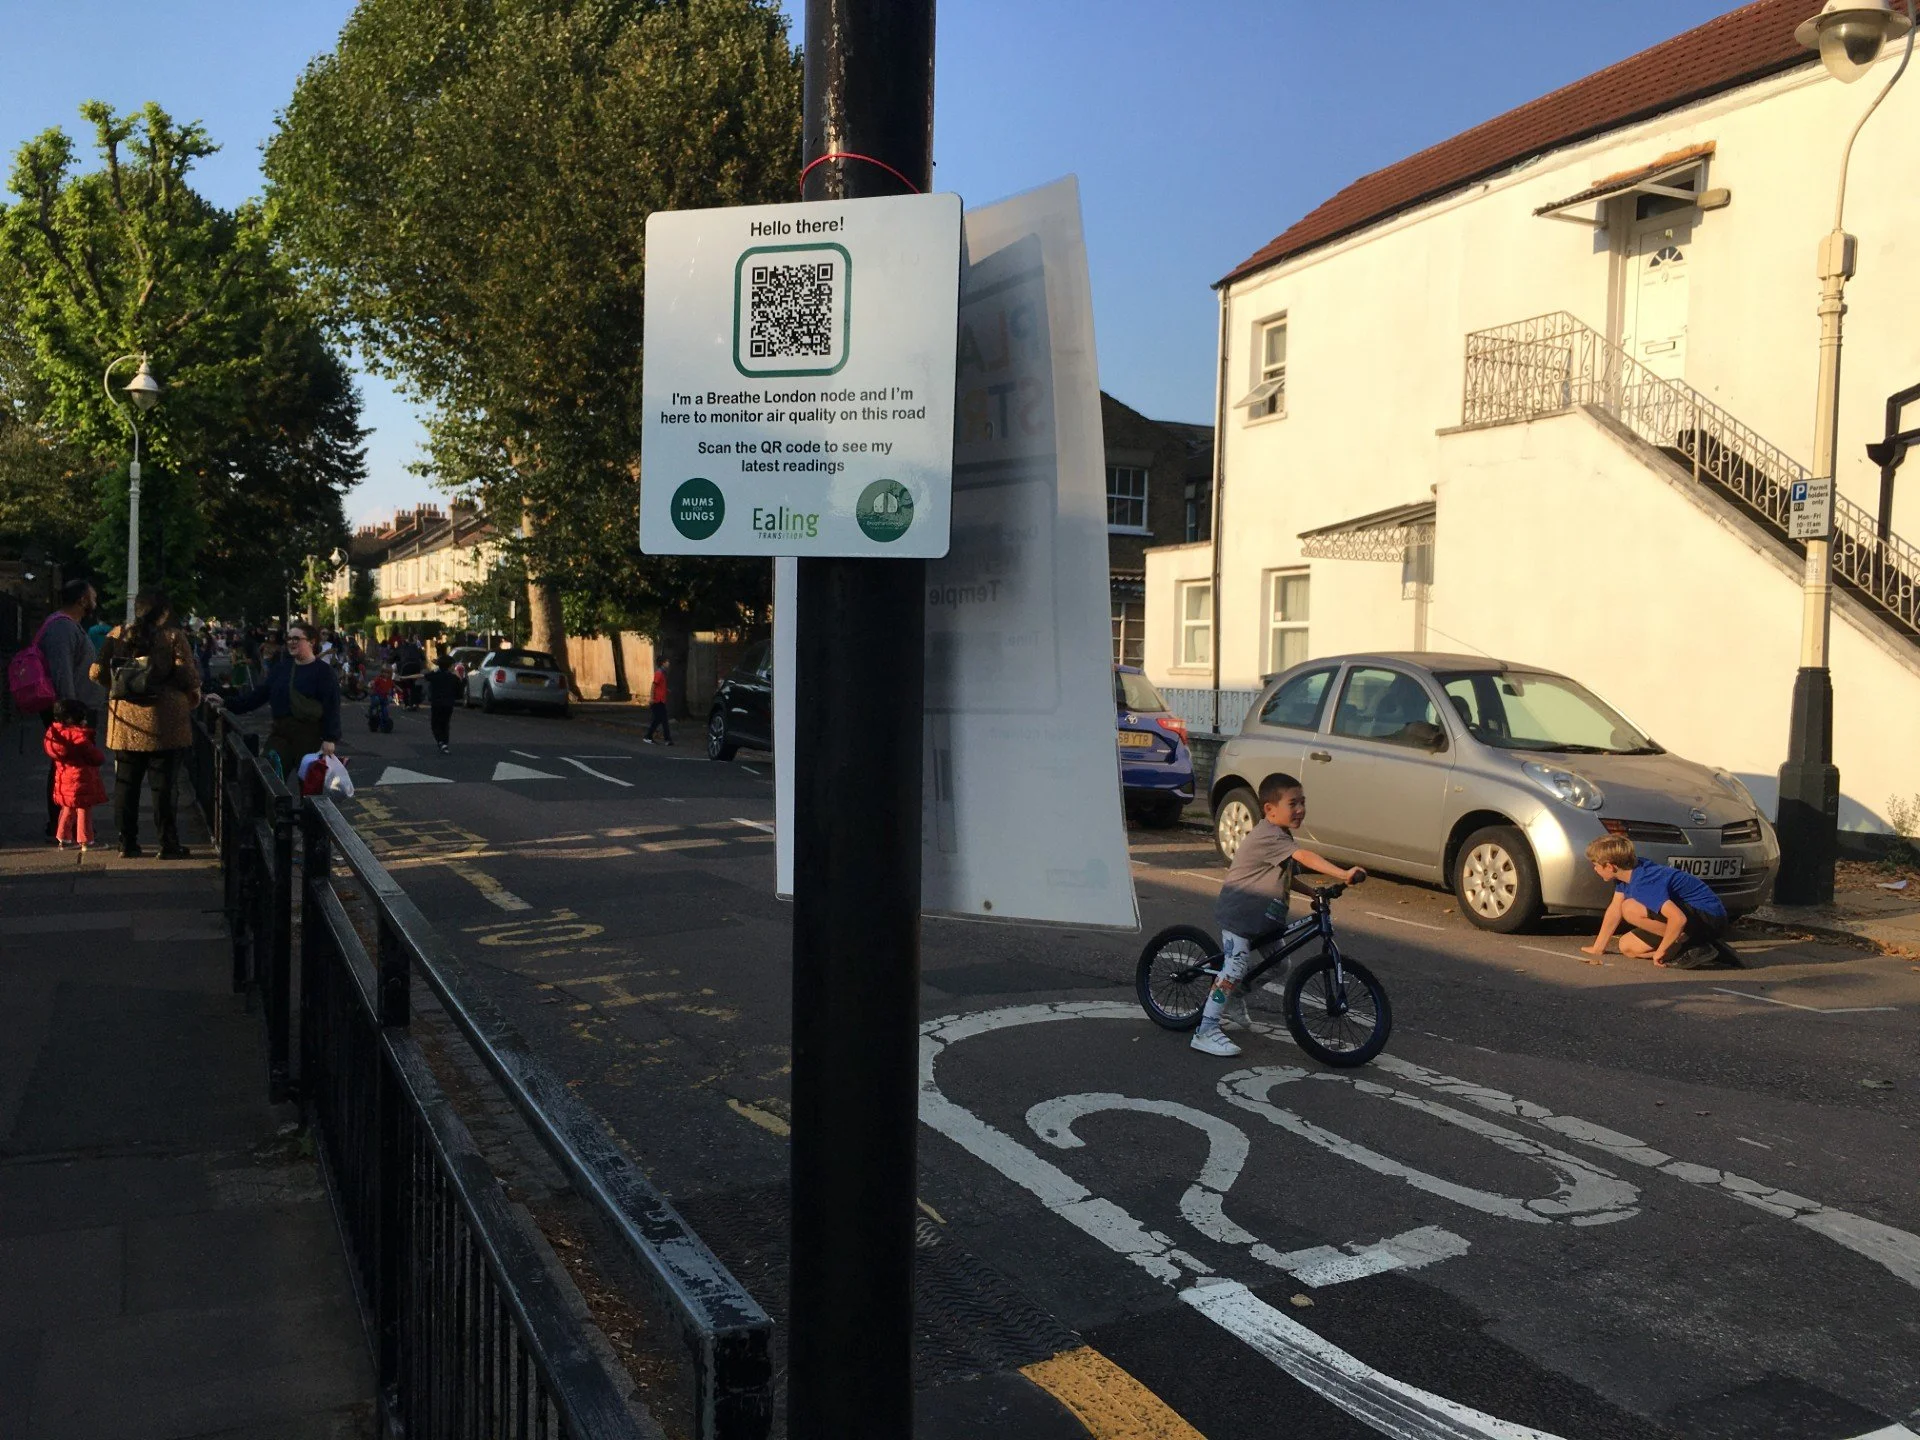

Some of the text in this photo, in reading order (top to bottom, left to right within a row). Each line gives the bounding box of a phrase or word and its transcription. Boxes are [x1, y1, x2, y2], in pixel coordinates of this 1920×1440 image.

[750, 215, 845, 237] Hello there!
[672, 392, 692, 406] I'm
[695, 395, 704, 405] a
[706, 390, 761, 405] Breathe
[764, 389, 817, 404] London
[820, 388, 856, 402] node
[859, 387, 888, 402] and
[660, 405, 926, 425] here to monitor air quality on this road
[698, 439, 893, 456] Scan the QR code to see my
[741, 459, 845, 475] latest readings
[1795, 484, 1806, 500] P
[681, 497, 714, 507] MUMS
[680, 511, 715, 521] LUNGS
[752, 506, 820, 538] Ealing
[757, 531, 804, 540] TRANSITION
[1674, 859, 1737, 876] WN03 UPS
[1025, 1065, 1642, 1288] 20
